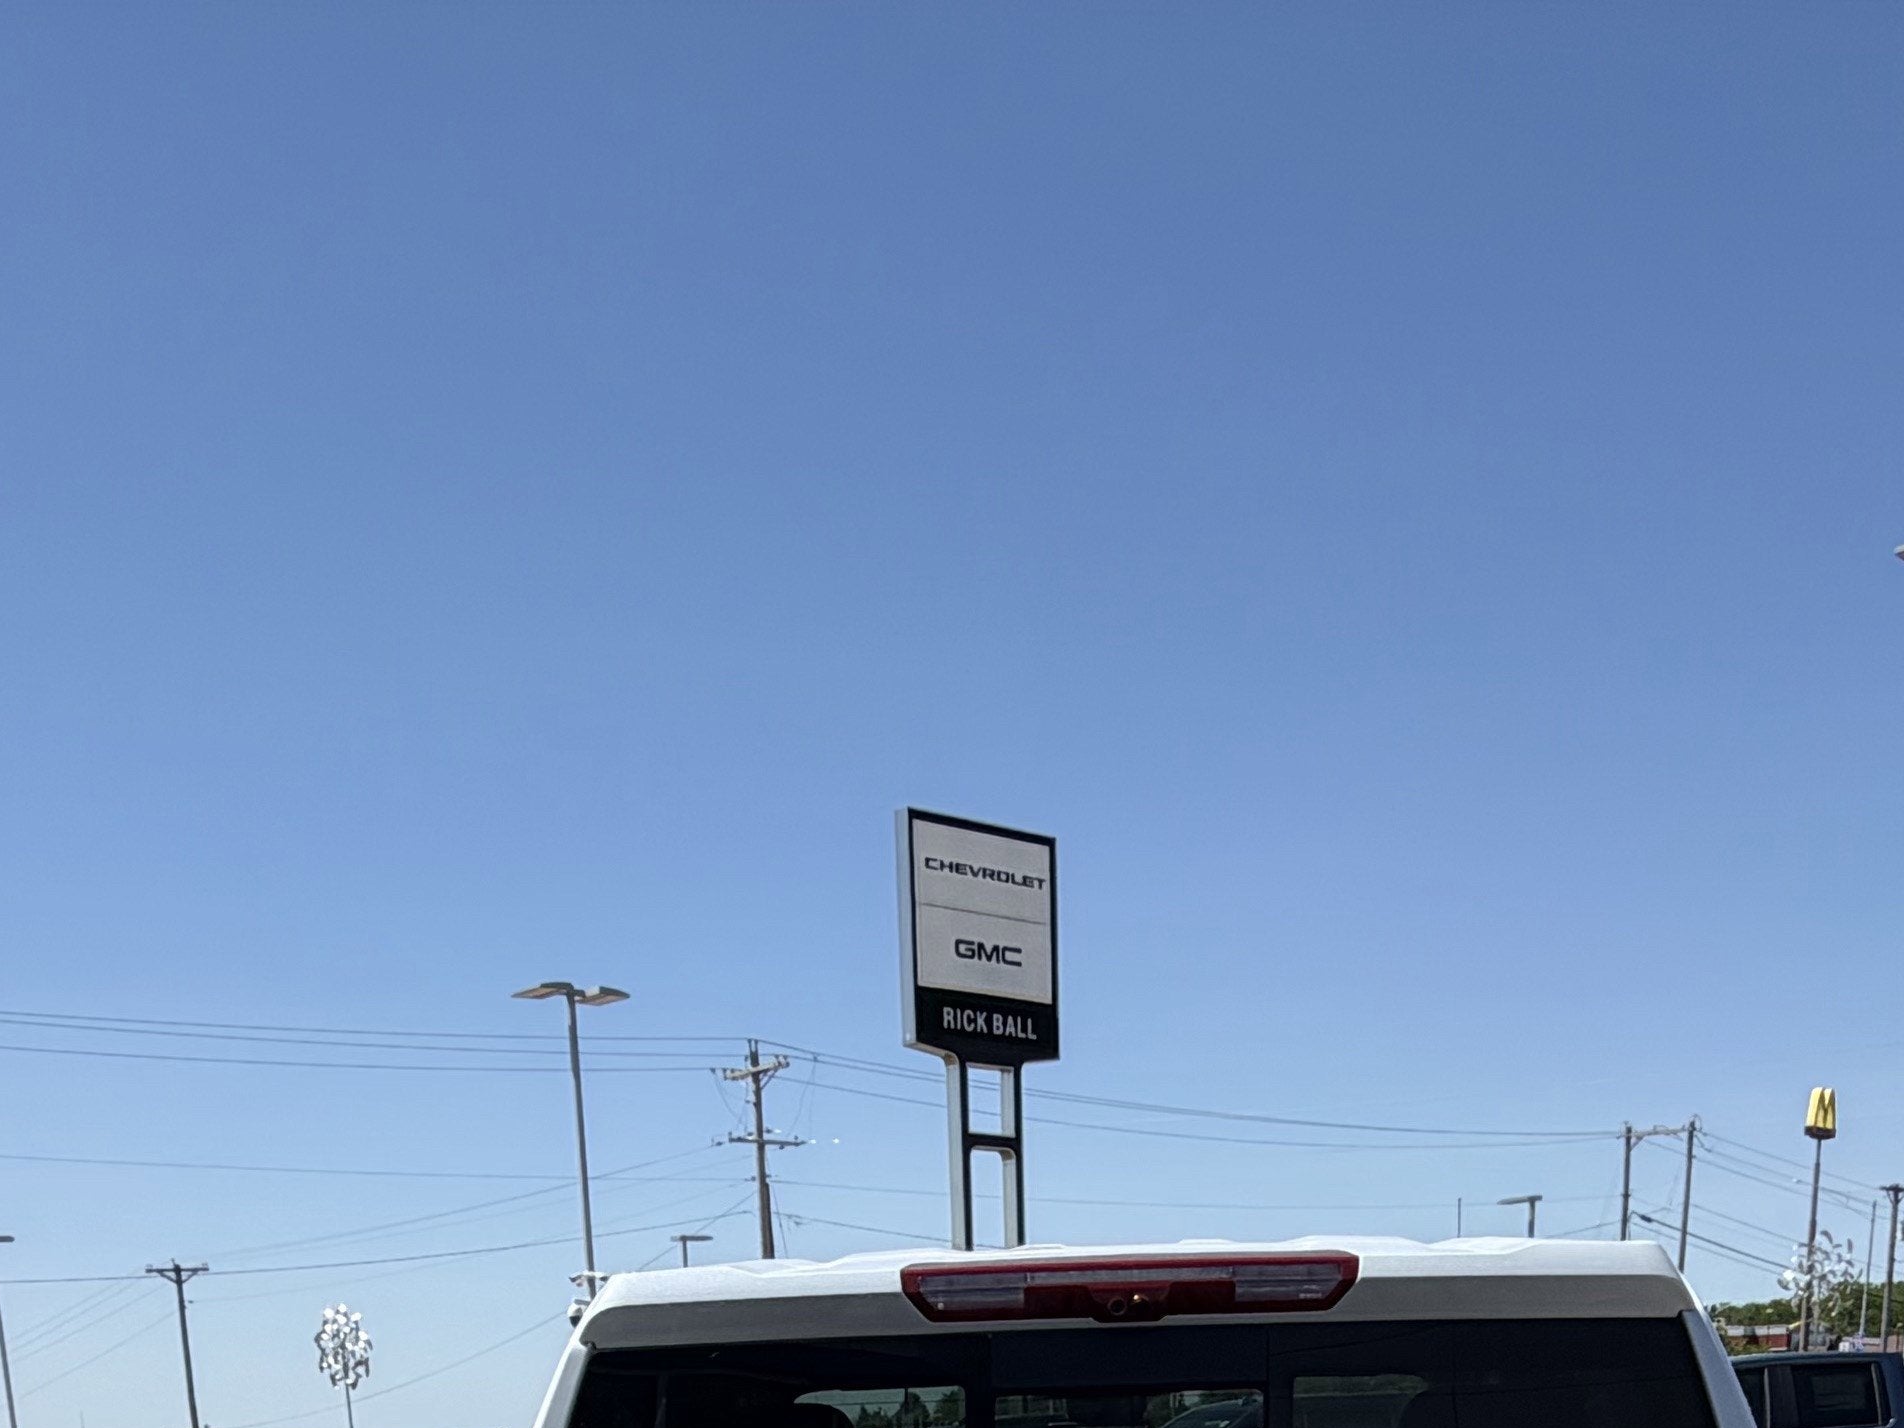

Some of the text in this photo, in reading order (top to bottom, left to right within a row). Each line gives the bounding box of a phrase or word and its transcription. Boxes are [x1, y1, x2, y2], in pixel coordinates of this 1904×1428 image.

[924, 857, 1046, 890] CHEVROLET
[954, 938, 1023, 967] GMC
[943, 1006, 1037, 1041] RICK BALL
